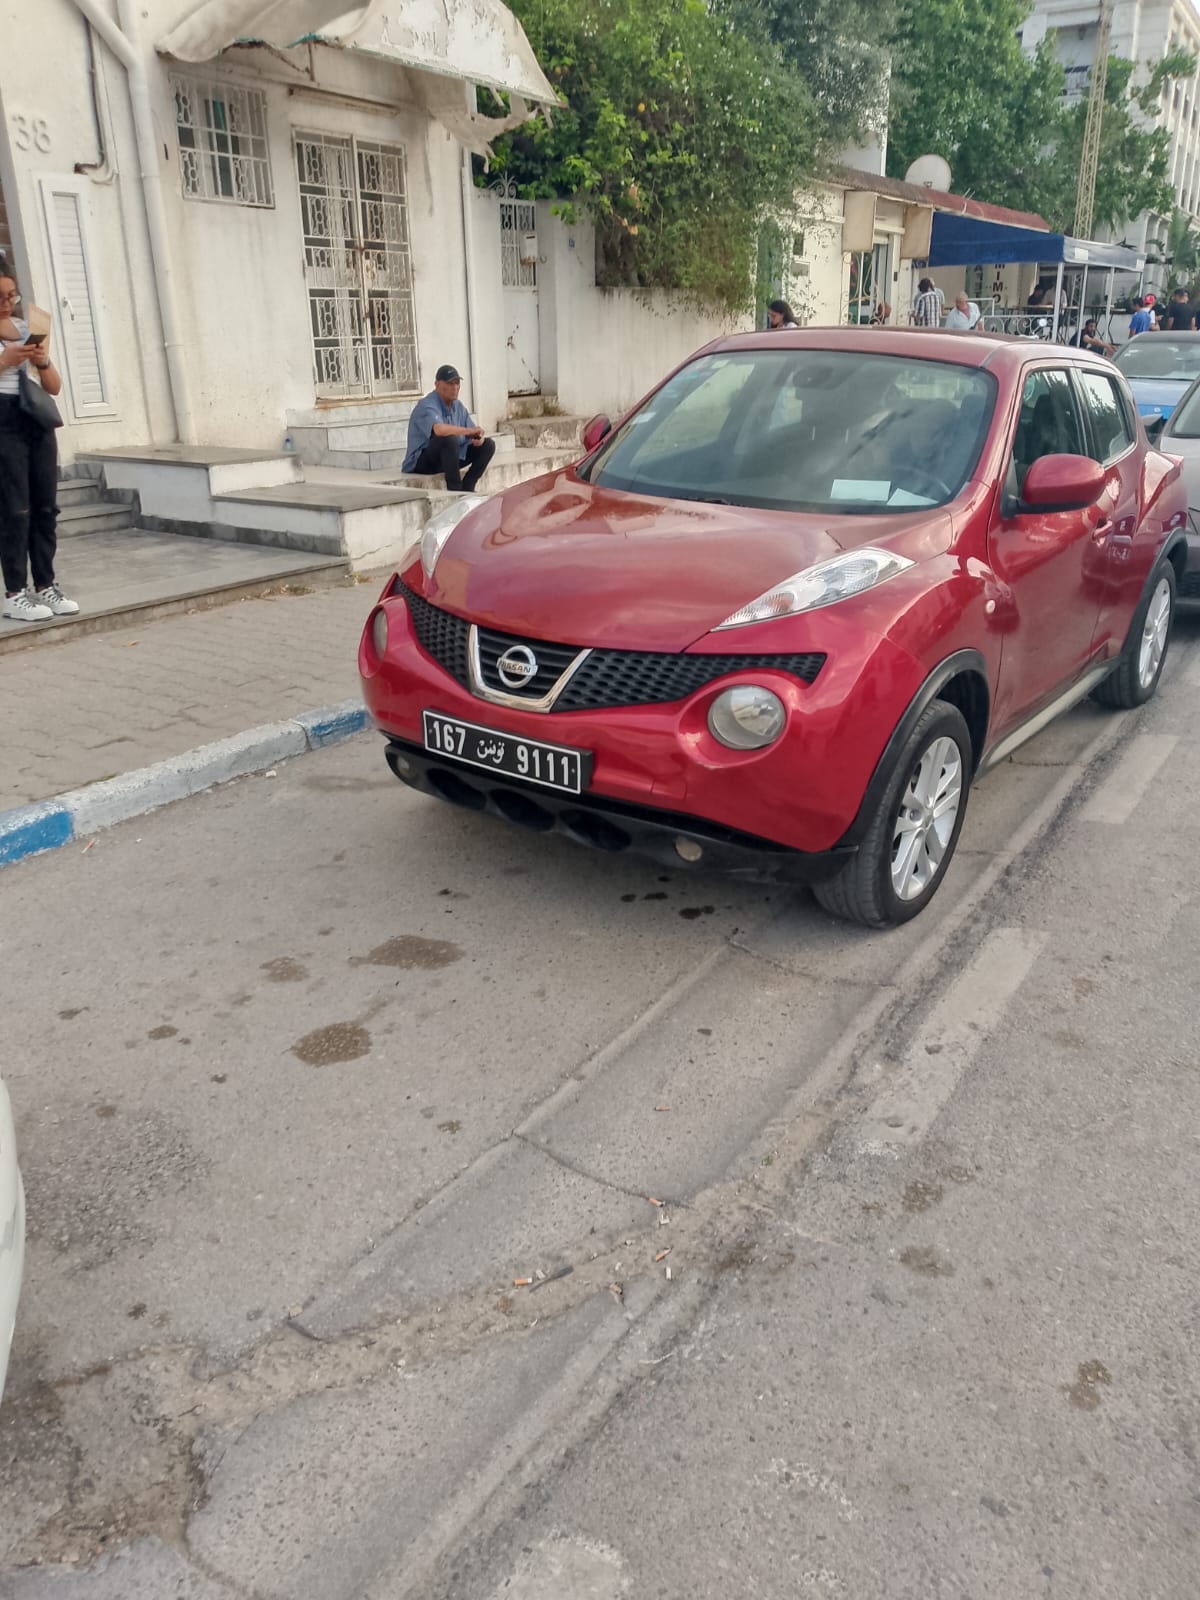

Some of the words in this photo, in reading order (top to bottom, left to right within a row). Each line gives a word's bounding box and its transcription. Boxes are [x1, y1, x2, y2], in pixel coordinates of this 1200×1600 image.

[12, 114, 52, 154] 38
[499, 660, 531, 673] NISSAN
[433, 720, 466, 755] 167
[476, 740, 505, 764] تونس
[516, 745, 570, 786] 9111
